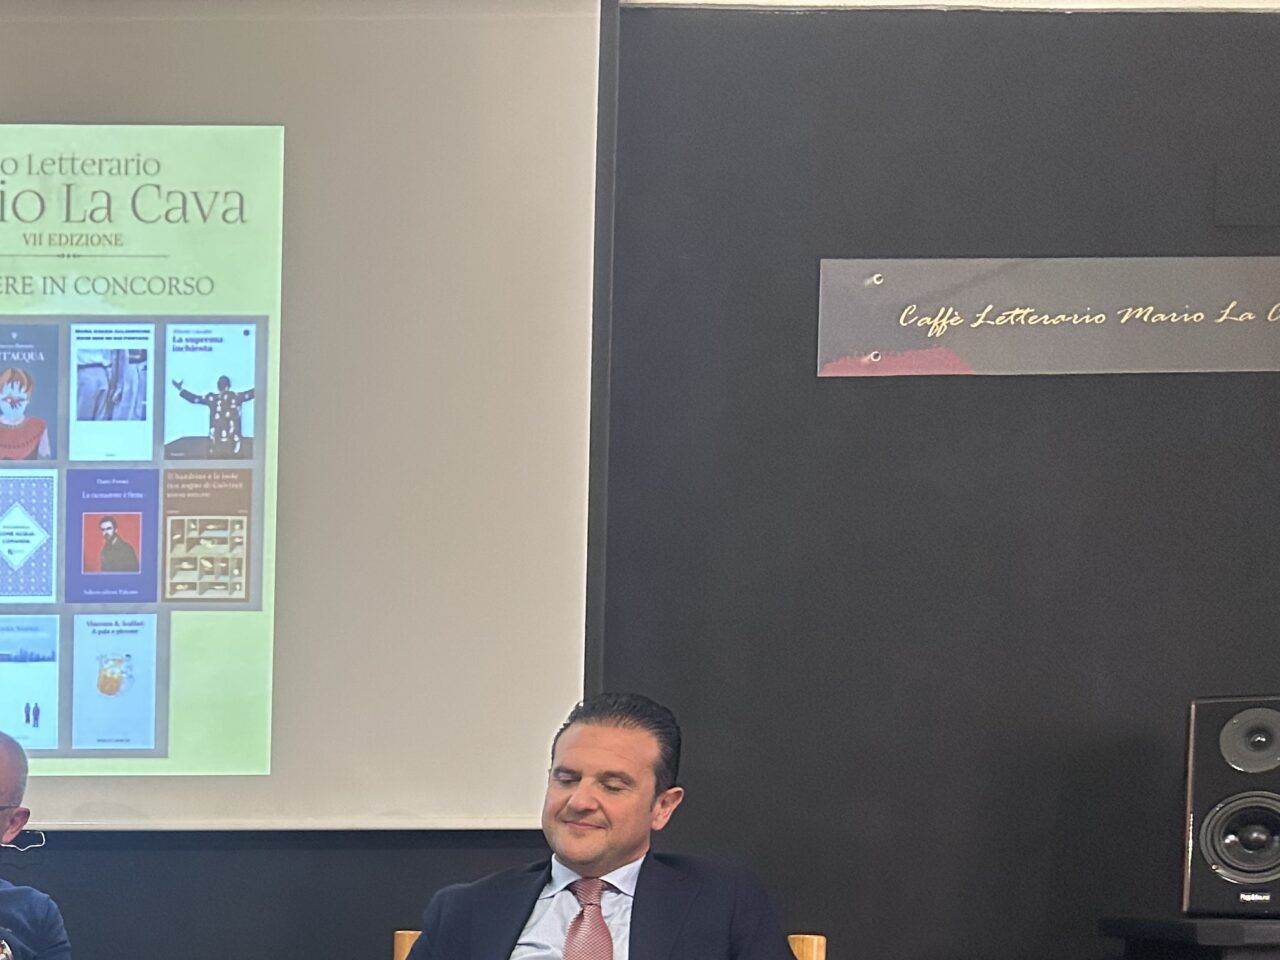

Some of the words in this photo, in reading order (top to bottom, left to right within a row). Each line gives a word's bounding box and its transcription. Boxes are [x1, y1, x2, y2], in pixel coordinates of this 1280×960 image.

[27, 152, 162, 177] Letterario
[61, 183, 114, 225] La
[130, 183, 248, 225] Cava
[22, 232, 43, 247] VII
[48, 232, 125, 248] EDIZIONE
[42, 276, 67, 296] IN
[73, 275, 216, 297] CONCORSO
[898, 303, 964, 338] Caffè
[970, 303, 1108, 329] Letterario
[1118, 304, 1205, 326] Mario
[1214, 300, 1256, 323] La
